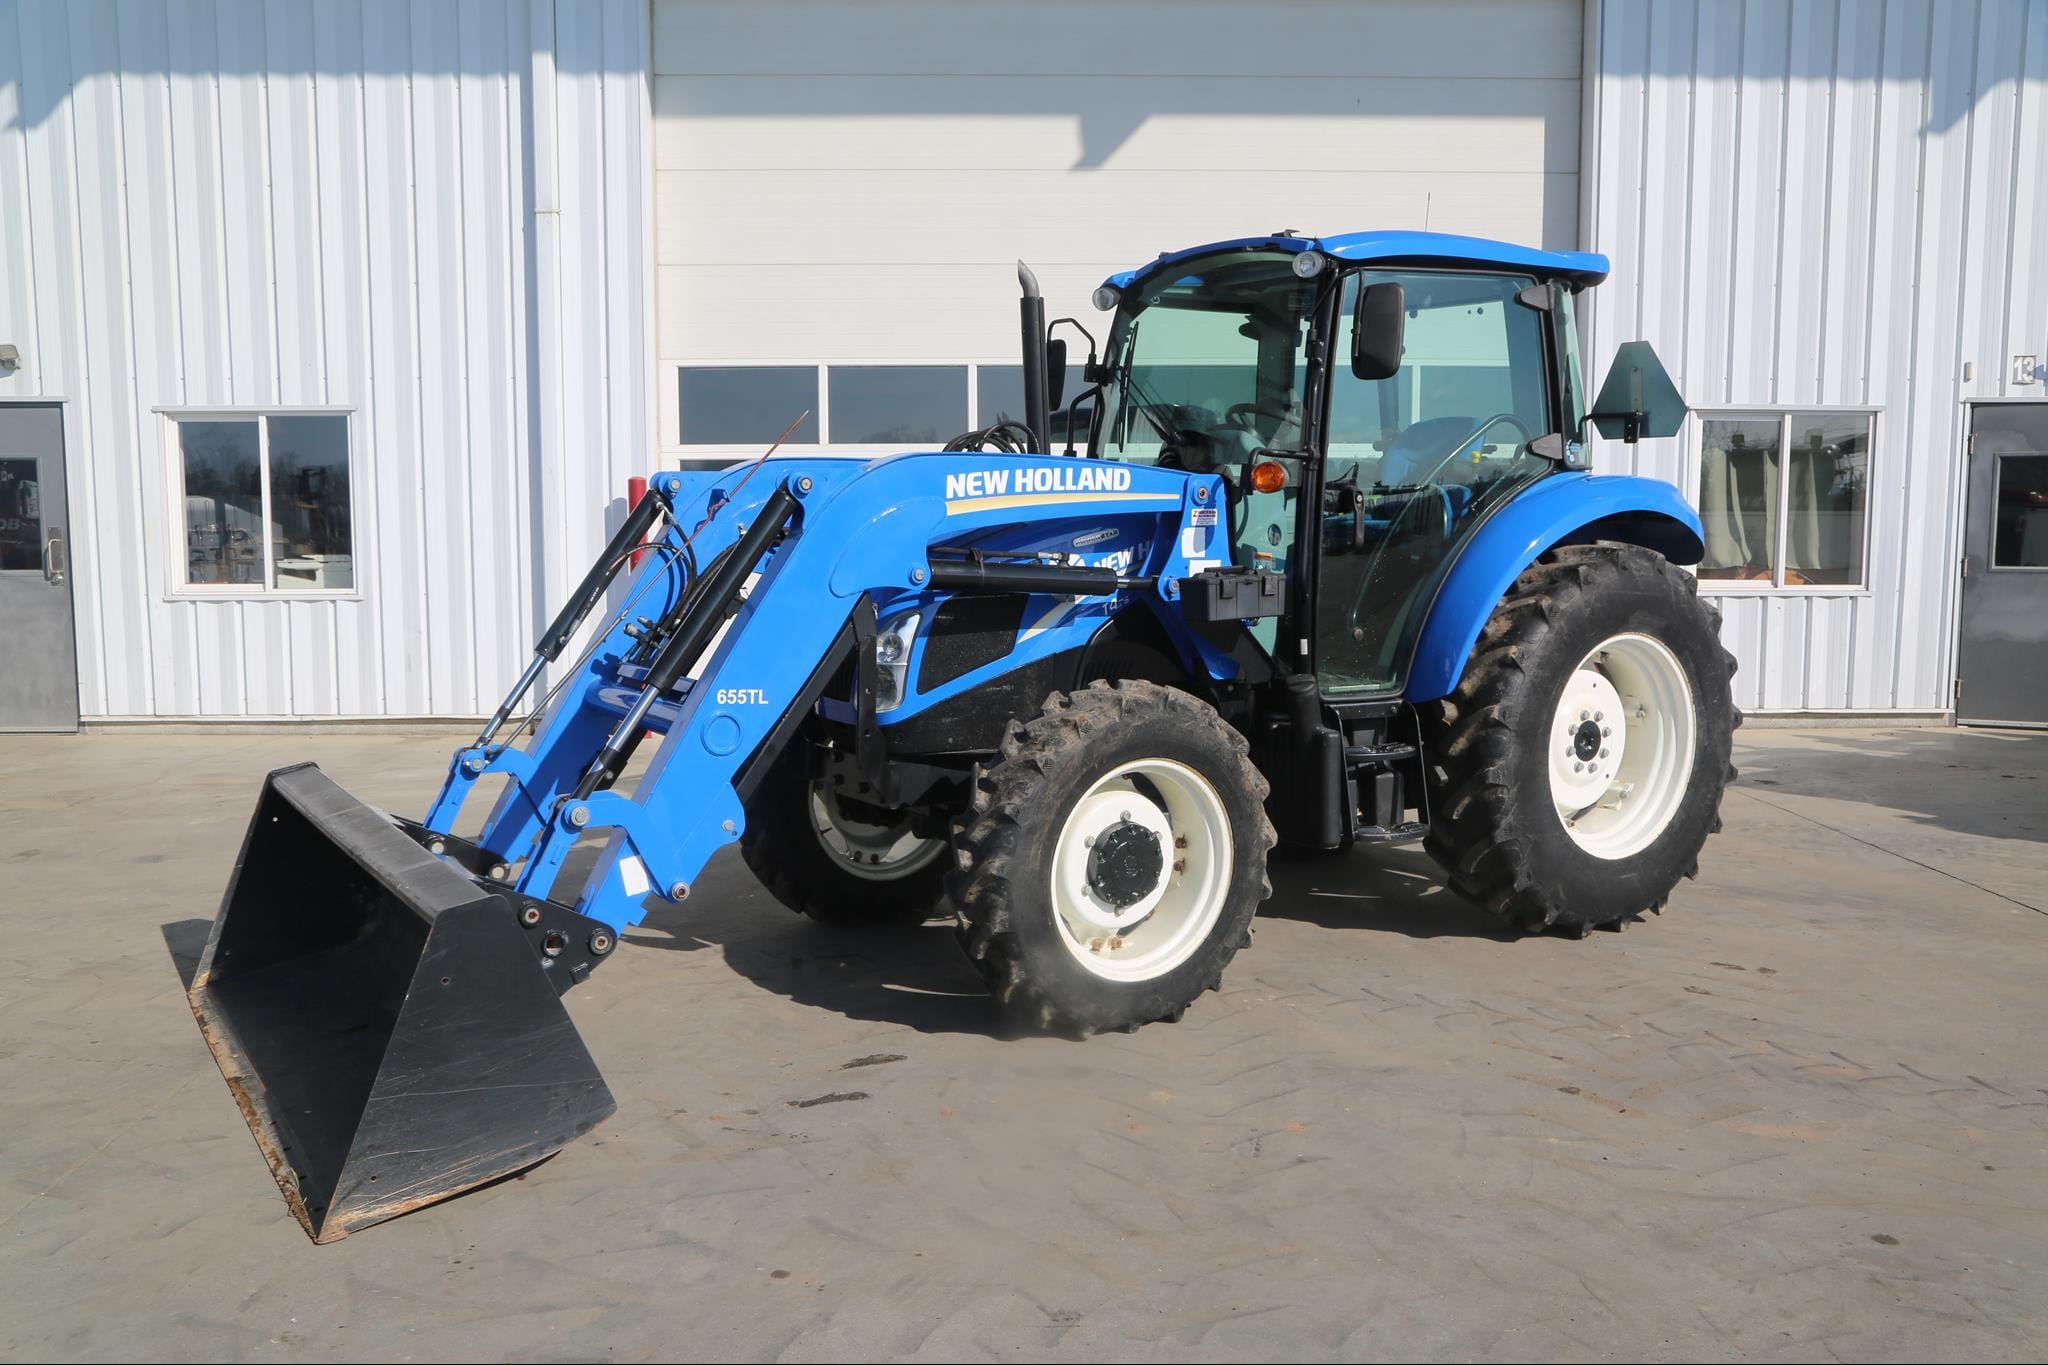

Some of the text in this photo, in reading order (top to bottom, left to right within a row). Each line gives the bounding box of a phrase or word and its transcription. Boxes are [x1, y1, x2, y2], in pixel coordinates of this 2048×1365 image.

[2014, 356, 2035, 383] 13
[946, 467, 1131, 499] NEW HOLLAND
[717, 689, 769, 705] 655TL
